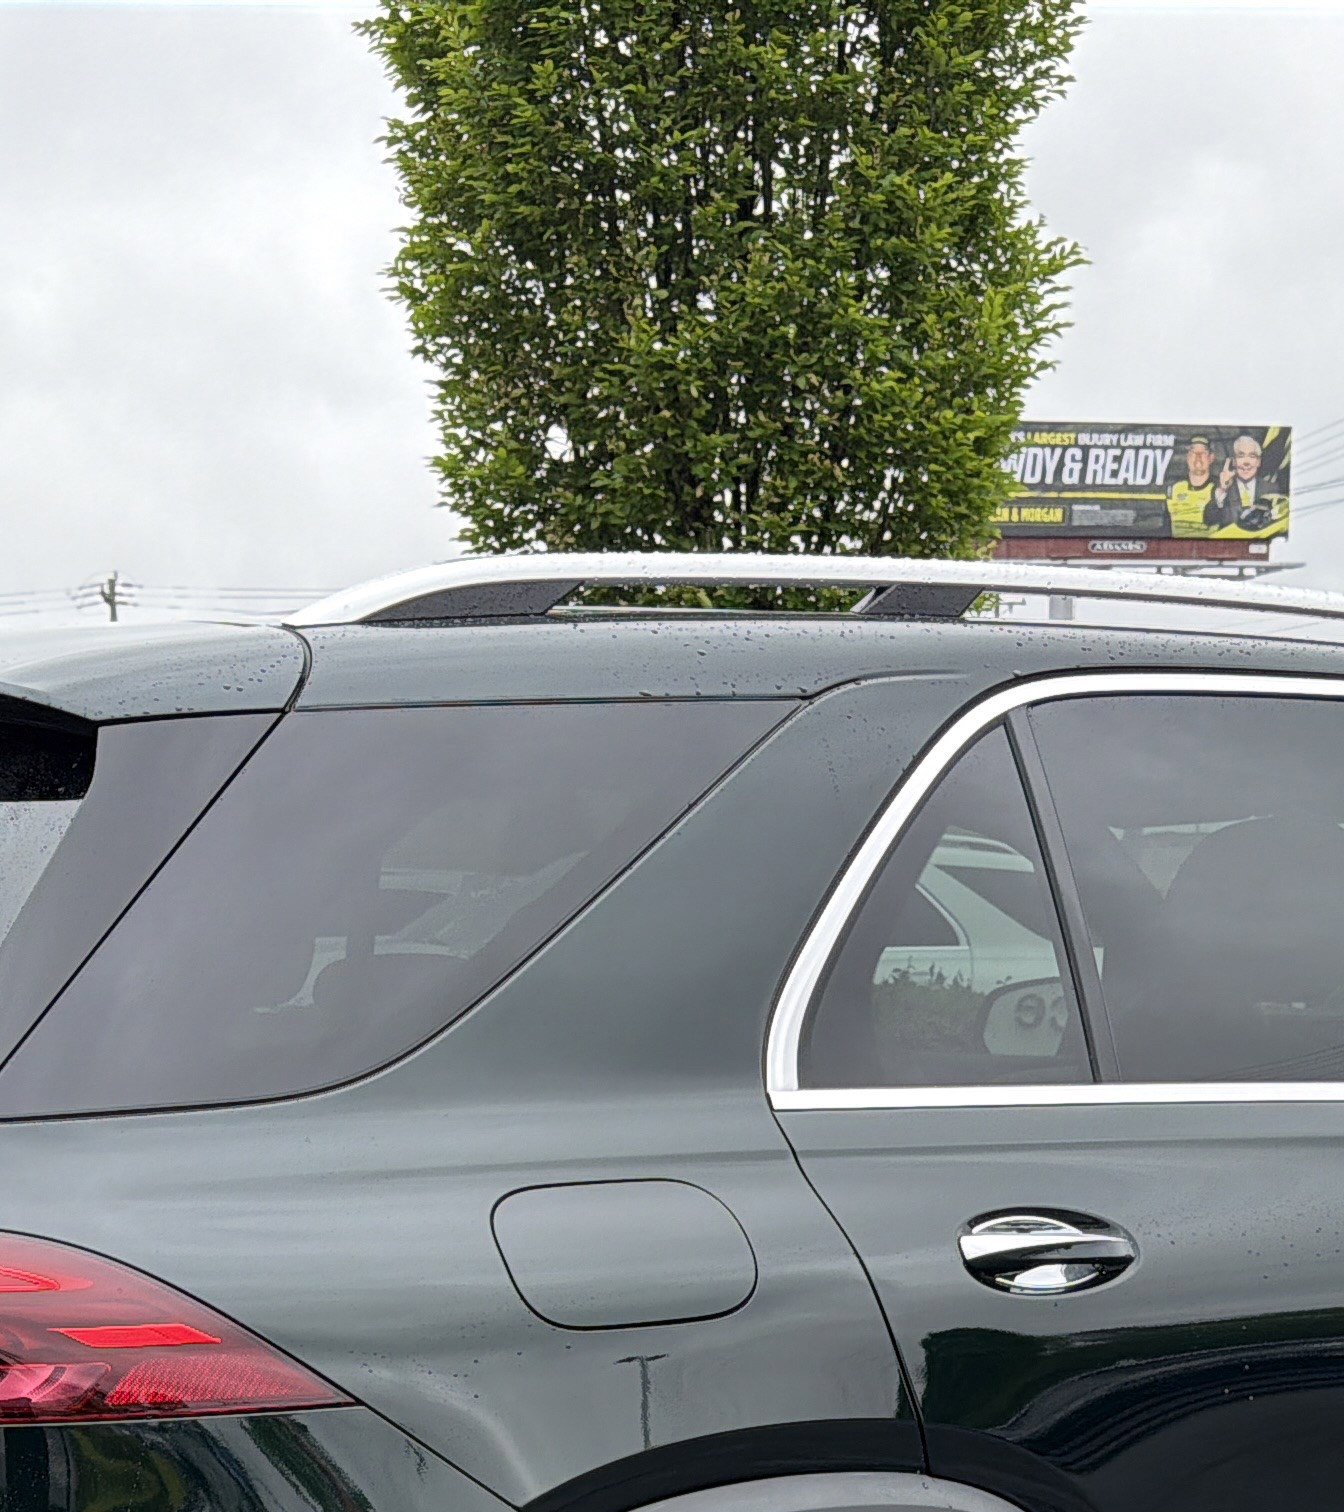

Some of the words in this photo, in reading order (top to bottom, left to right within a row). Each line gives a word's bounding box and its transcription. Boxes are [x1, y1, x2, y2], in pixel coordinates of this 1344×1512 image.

[1146, 433, 1175, 447] FIRM
[1061, 447, 1084, 485] &
[1084, 448, 1175, 486] READY
[1020, 507, 1063, 522] MORGAN
